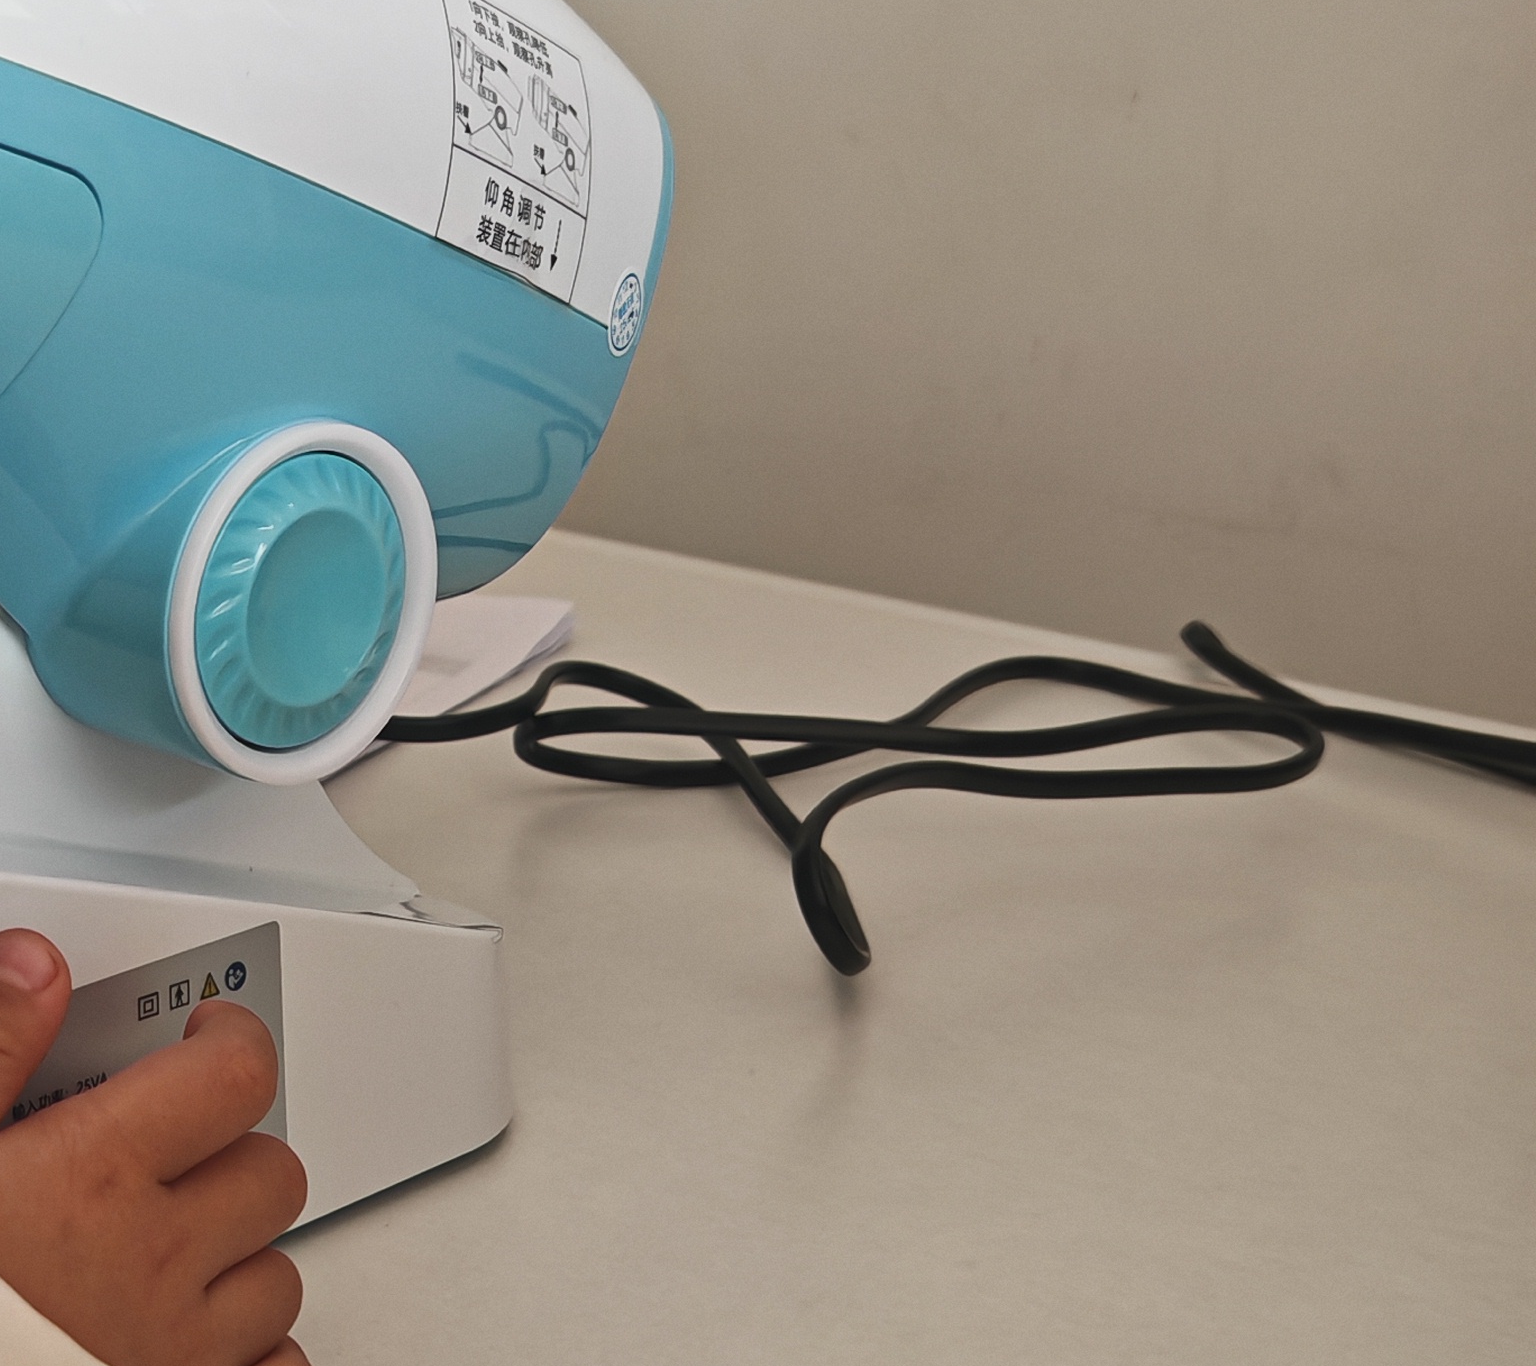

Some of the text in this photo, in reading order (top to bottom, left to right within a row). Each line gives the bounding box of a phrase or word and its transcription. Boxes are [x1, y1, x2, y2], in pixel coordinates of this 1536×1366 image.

[485, 176, 546, 231] 仰角调节
[476, 215, 544, 271] 装置在内部
